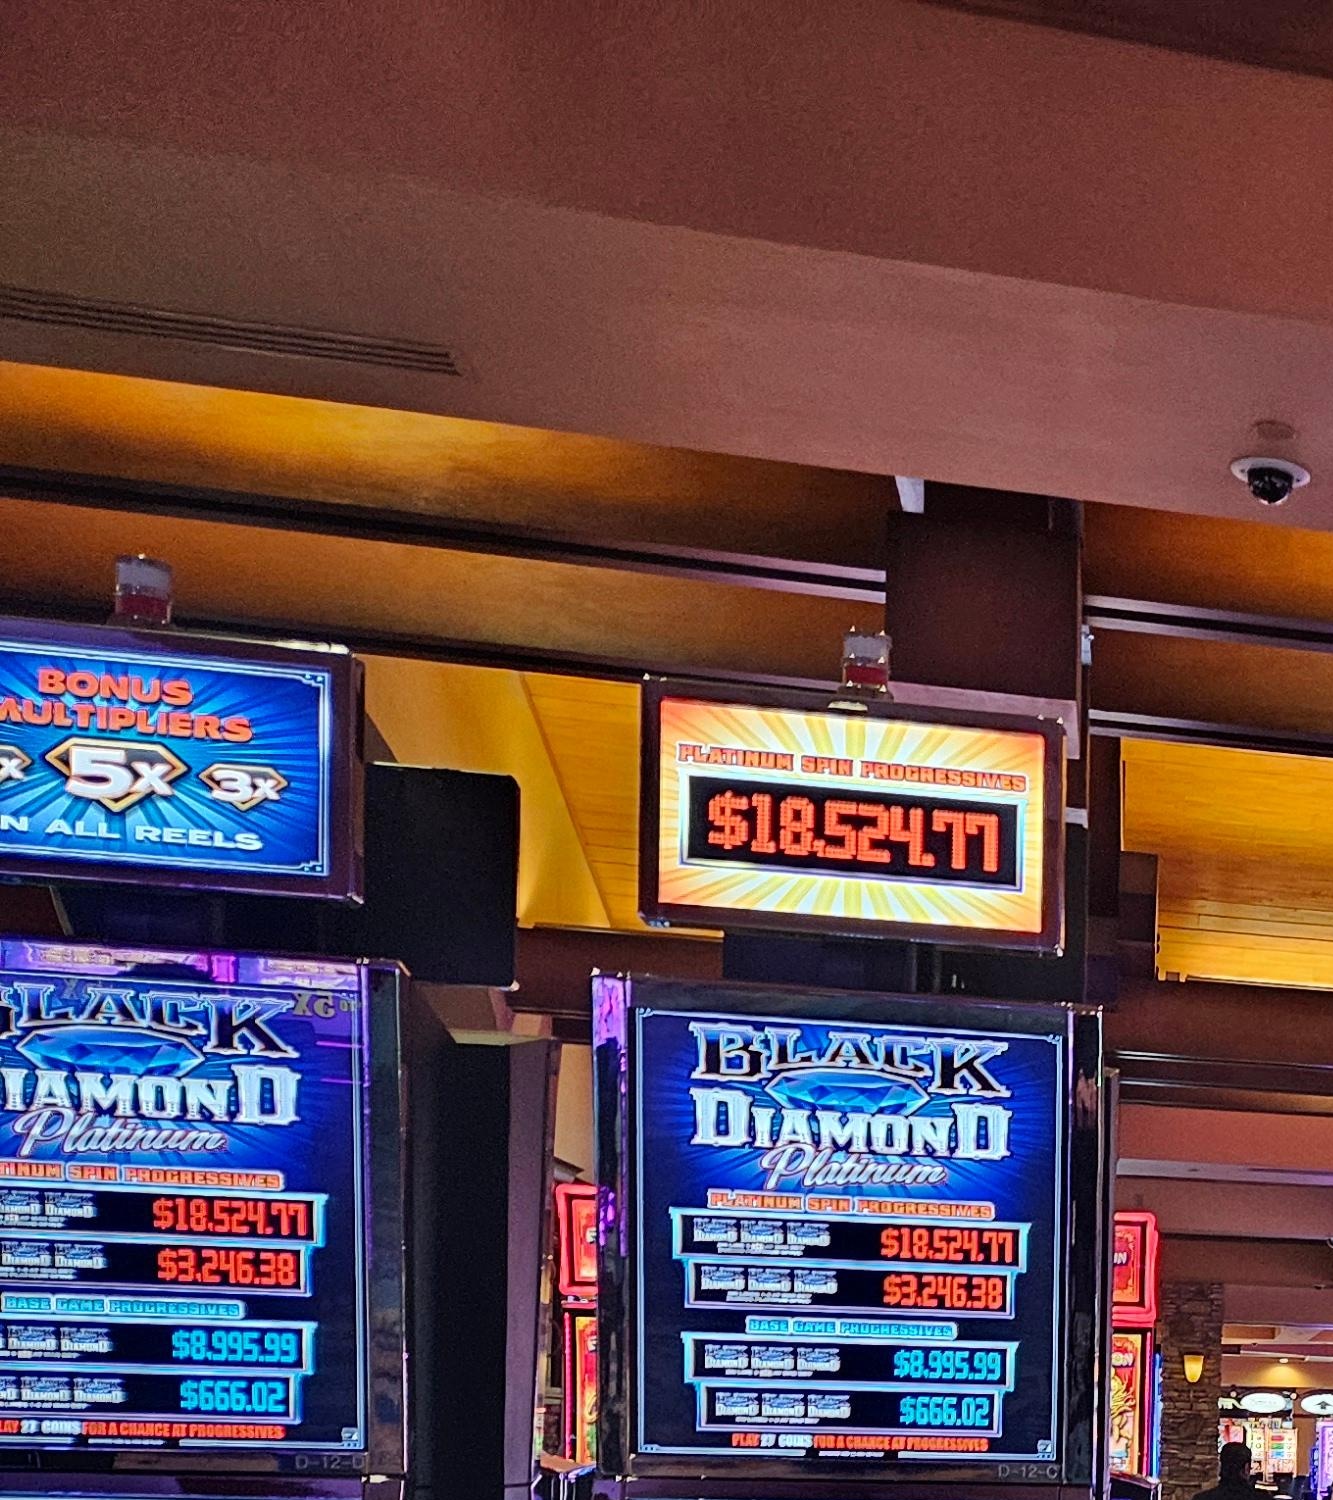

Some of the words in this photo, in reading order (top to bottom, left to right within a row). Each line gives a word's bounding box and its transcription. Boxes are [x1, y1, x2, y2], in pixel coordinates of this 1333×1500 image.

[38, 668, 193, 706] BONUS
[67, 746, 175, 801] 5x
[209, 769, 282, 802] 3x
[678, 744, 794, 773] PLATINUM
[801, 756, 853, 778] SPIN
[860, 761, 1027, 793] PROGRESSIVES
[0, 814, 29, 832] N
[45, 818, 121, 840] ALL
[134, 824, 263, 851] REELS
[708, 790, 999, 873] $18,524.77
[689, 1021, 1011, 1098] BLACK
[0, 1064, 301, 1126] IAMOND
[13, 1108, 227, 1157] Platinum
[690, 1087, 1013, 1160] DIAMOND
[68, 1166, 118, 1182] SPIN
[125, 1168, 281, 1189] PROGRESSIVES
[761, 1143, 947, 1190] Platinum
[152, 1197, 308, 1236] $18,524.77
[710, 1193, 801, 1210] PLATINUM
[807, 1197, 850, 1212] SPIN
[858, 1200, 992, 1218] PROGRESSIVES
[880, 1228, 1013, 1263] $18,524.77
[157, 1248, 297, 1286] $3,246.38
[5, 1296, 51, 1310] BASE
[56, 1298, 104, 1312] GAME
[109, 1300, 240, 1317] PROGRESSIVES
[883, 1274, 1002, 1309] $3,246.38
[172, 1330, 298, 1363] $8,995.99
[749, 1320, 788, 1332] BASE
[794, 1322, 835, 1334] GAME
[841, 1323, 953, 1337] PROGRESSIVES
[894, 1350, 1001, 1380] $8,995.99
[180, 1380, 286, 1413] $666.02
[900, 1396, 989, 1426] $666.02
[0, 1419, 19, 1433] LAY
[41, 1420, 82, 1435] COINS
[82, 1421, 107, 1436] FOR
[119, 1422, 171, 1437] CHANCE
[189, 1424, 286, 1439] PROGRESSIVES
